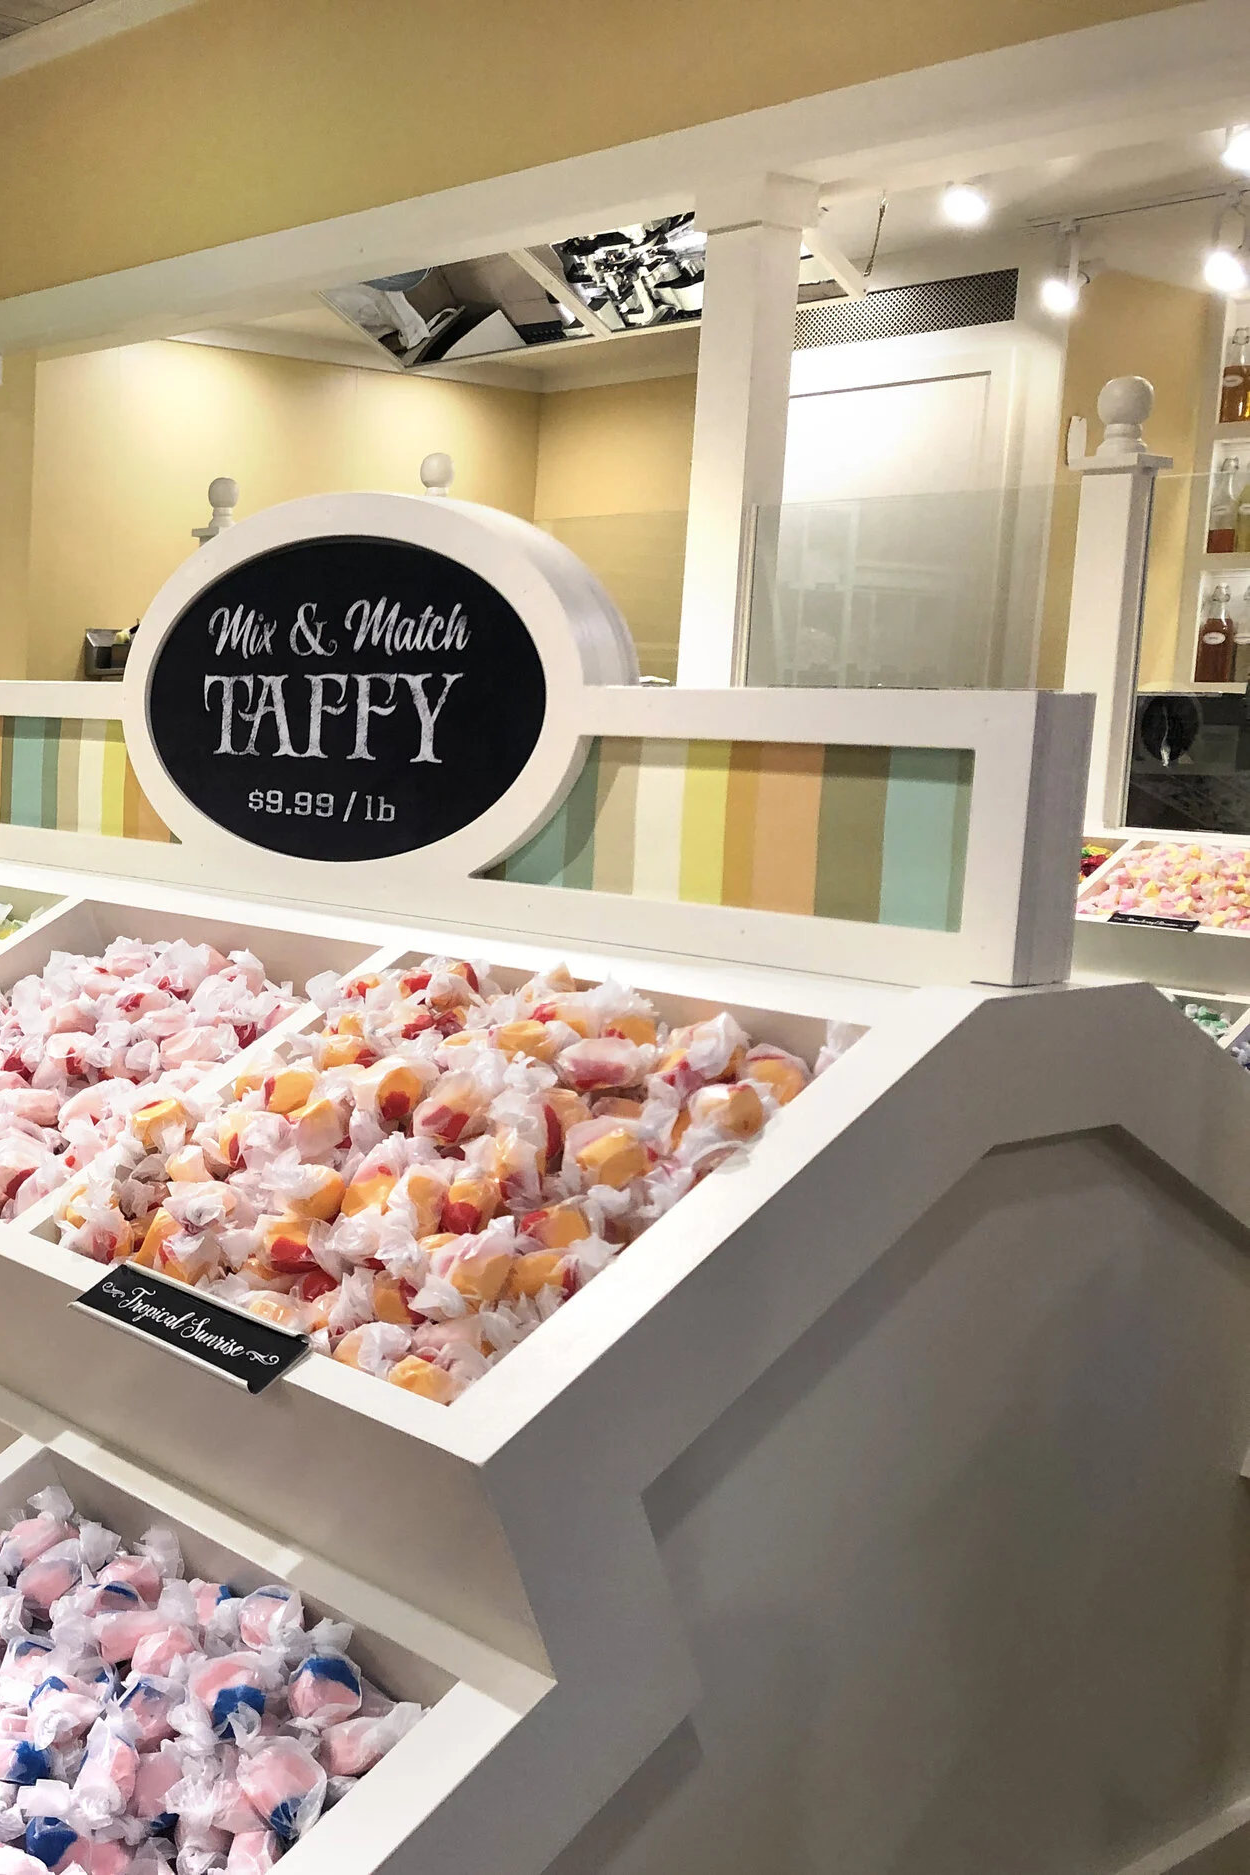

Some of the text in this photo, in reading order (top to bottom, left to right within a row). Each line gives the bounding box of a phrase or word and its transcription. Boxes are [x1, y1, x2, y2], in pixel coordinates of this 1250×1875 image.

[207, 596, 472, 659] Mix & Match
[203, 672, 464, 764] TAFFY
[248, 789, 397, 823] $9.99 / lb
[118, 1287, 246, 1357] Tropical Sunrise
